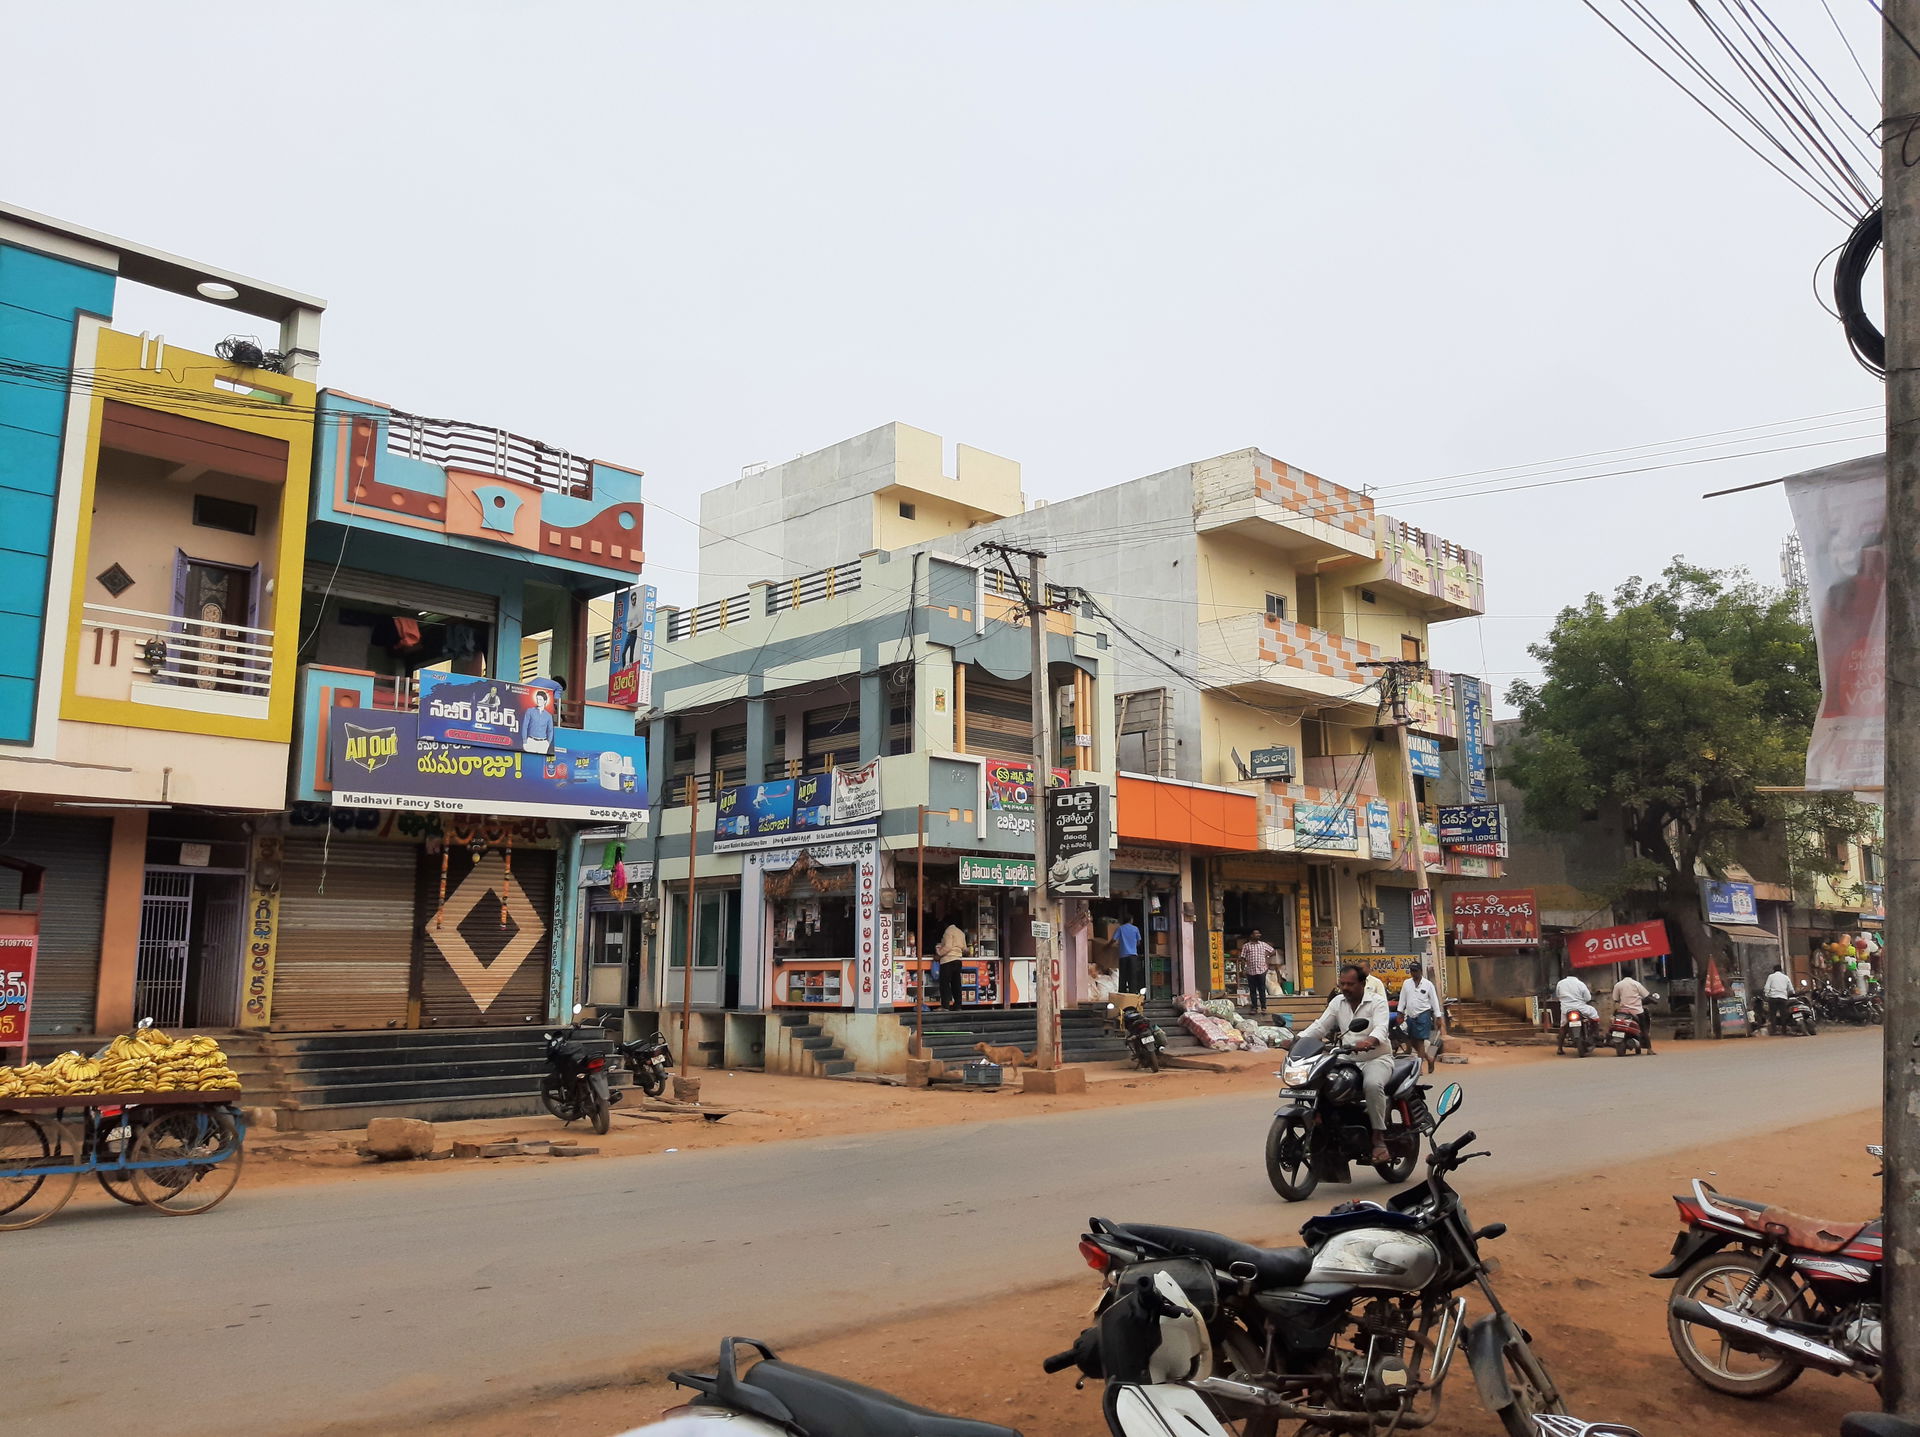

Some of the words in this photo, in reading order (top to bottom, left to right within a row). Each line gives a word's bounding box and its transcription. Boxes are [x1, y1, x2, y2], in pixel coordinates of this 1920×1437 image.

[345, 736, 367, 761] All
[369, 732, 398, 757] Out
[417, 752, 523, 779] యమరాజు!
[343, 794, 393, 806] Madhavi
[396, 797, 430, 809] Fancy
[433, 800, 464, 809] Store
[1413, 895, 1427, 906] LUV
[1603, 930, 1649, 951] airtel
